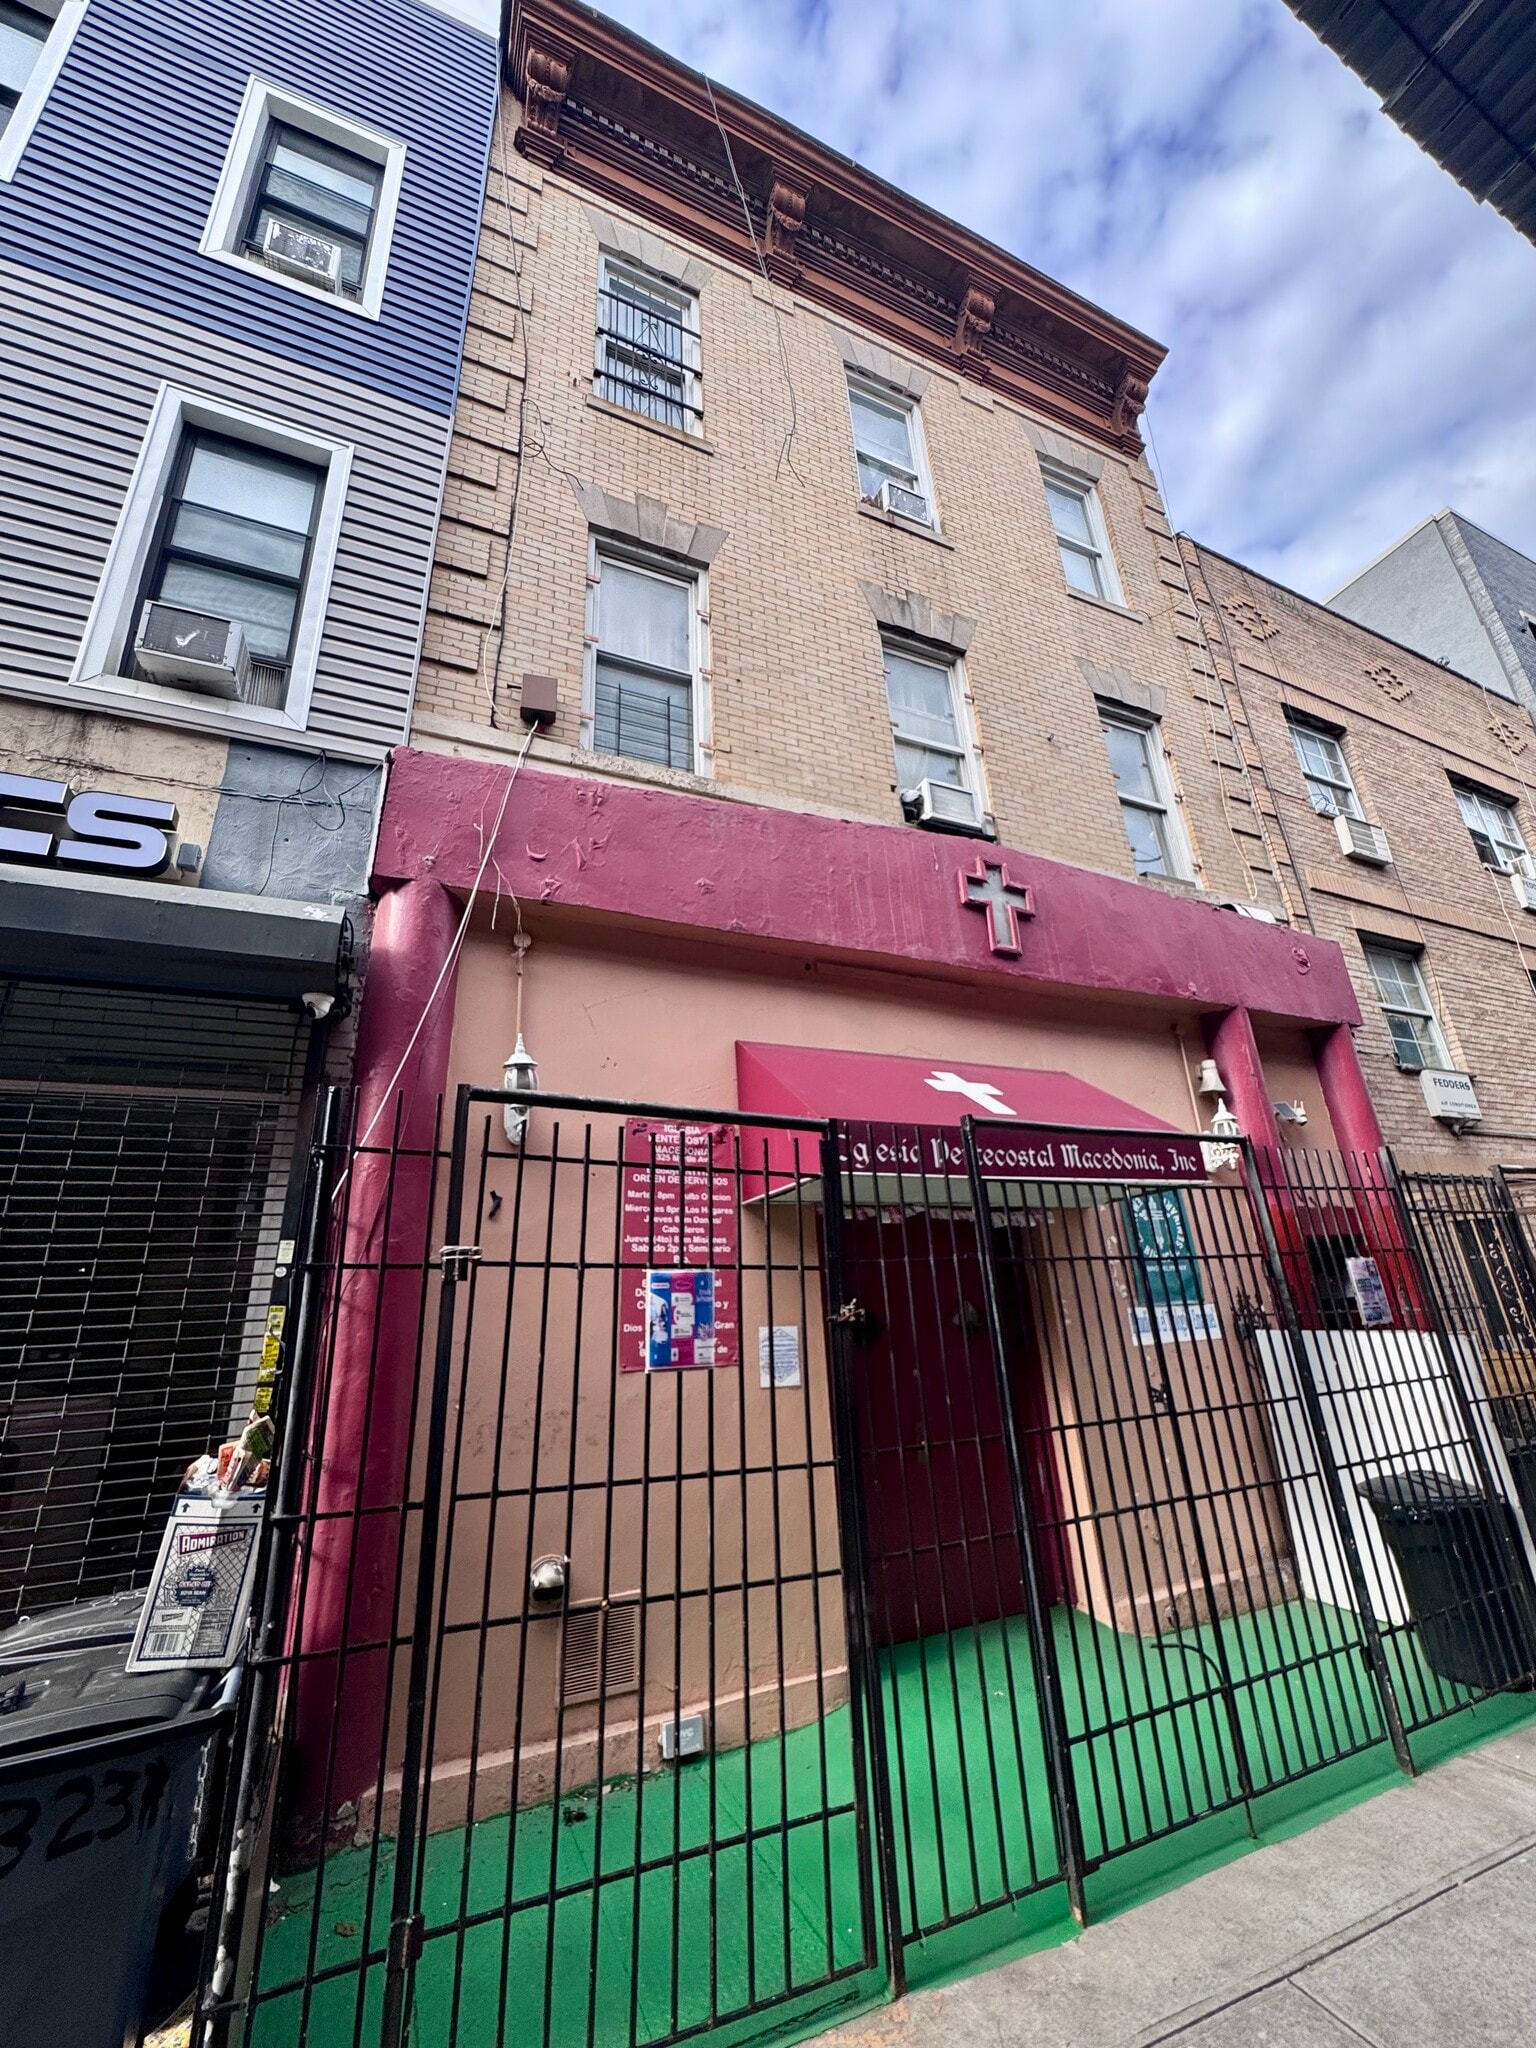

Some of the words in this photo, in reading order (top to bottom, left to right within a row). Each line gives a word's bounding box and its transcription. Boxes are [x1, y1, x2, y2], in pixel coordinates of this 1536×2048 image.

[1433, 1077, 1471, 1091] FEDDERS
[648, 1134, 715, 1146] ENTEOST
[654, 1145, 709, 1156] MACEONIA
[836, 1122, 919, 1169] gesia
[930, 1137, 1055, 1169] Petecostal
[1060, 1143, 1165, 1174] Macedonia,
[1167, 1148, 1198, 1172] Inc
[668, 1175, 680, 1184] DE
[684, 1176, 728, 1186] ERVIIOS
[657, 1191, 675, 1200] 8pm
[681, 1193, 700, 1201] ulto
[625, 1203, 665, 1212] Miercoes
[685, 1206, 700, 1214] Los
[701, 1206, 733, 1215] Hgares
[643, 1215, 672, 1223] Jeves
[674, 1216, 692, 1224] 8m
[662, 1225, 705, 1234] Cableros
[624, 1235, 653, 1243] Jueve
[673, 1236, 692, 1244] 8m
[693, 1236, 727, 1244] Misines
[631, 1244, 665, 1252] Sabdo
[688, 1245, 731, 1253] Semiario
[624, 1323, 642, 1333] Dios
[181, 1530, 246, 1553] ADMIRATION
